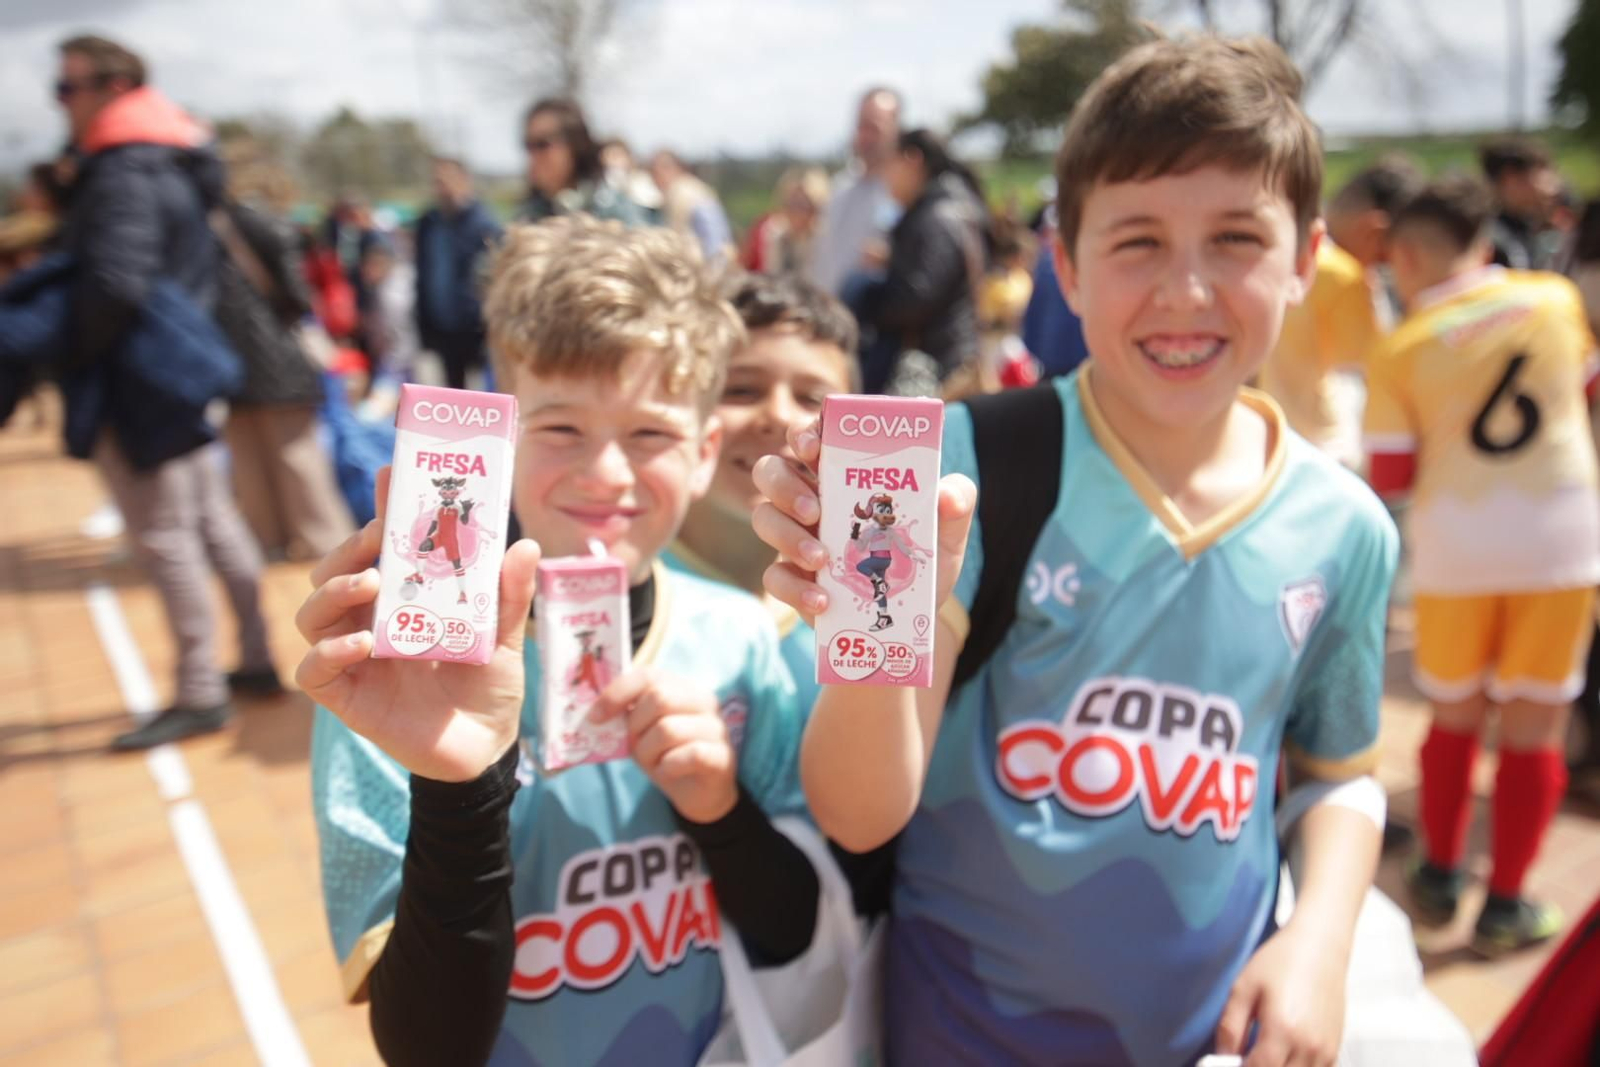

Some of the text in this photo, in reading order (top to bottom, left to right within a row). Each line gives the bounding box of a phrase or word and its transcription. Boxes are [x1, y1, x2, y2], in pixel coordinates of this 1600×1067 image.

[412, 400, 501, 428] COVAP
[1471, 353, 1540, 455] 6
[839, 413, 931, 438] COVAP
[416, 451, 487, 477] FRESA
[845, 467, 919, 492] FRESA
[396, 612, 436, 634] 95%
[391, 634, 403, 642] DE
[405, 634, 436, 644] LECHE
[836, 637, 877, 658] 95%
[847, 660, 877, 668] LECHE
[1075, 686, 1236, 752] COPA
[999, 726, 1255, 829] COVAP
